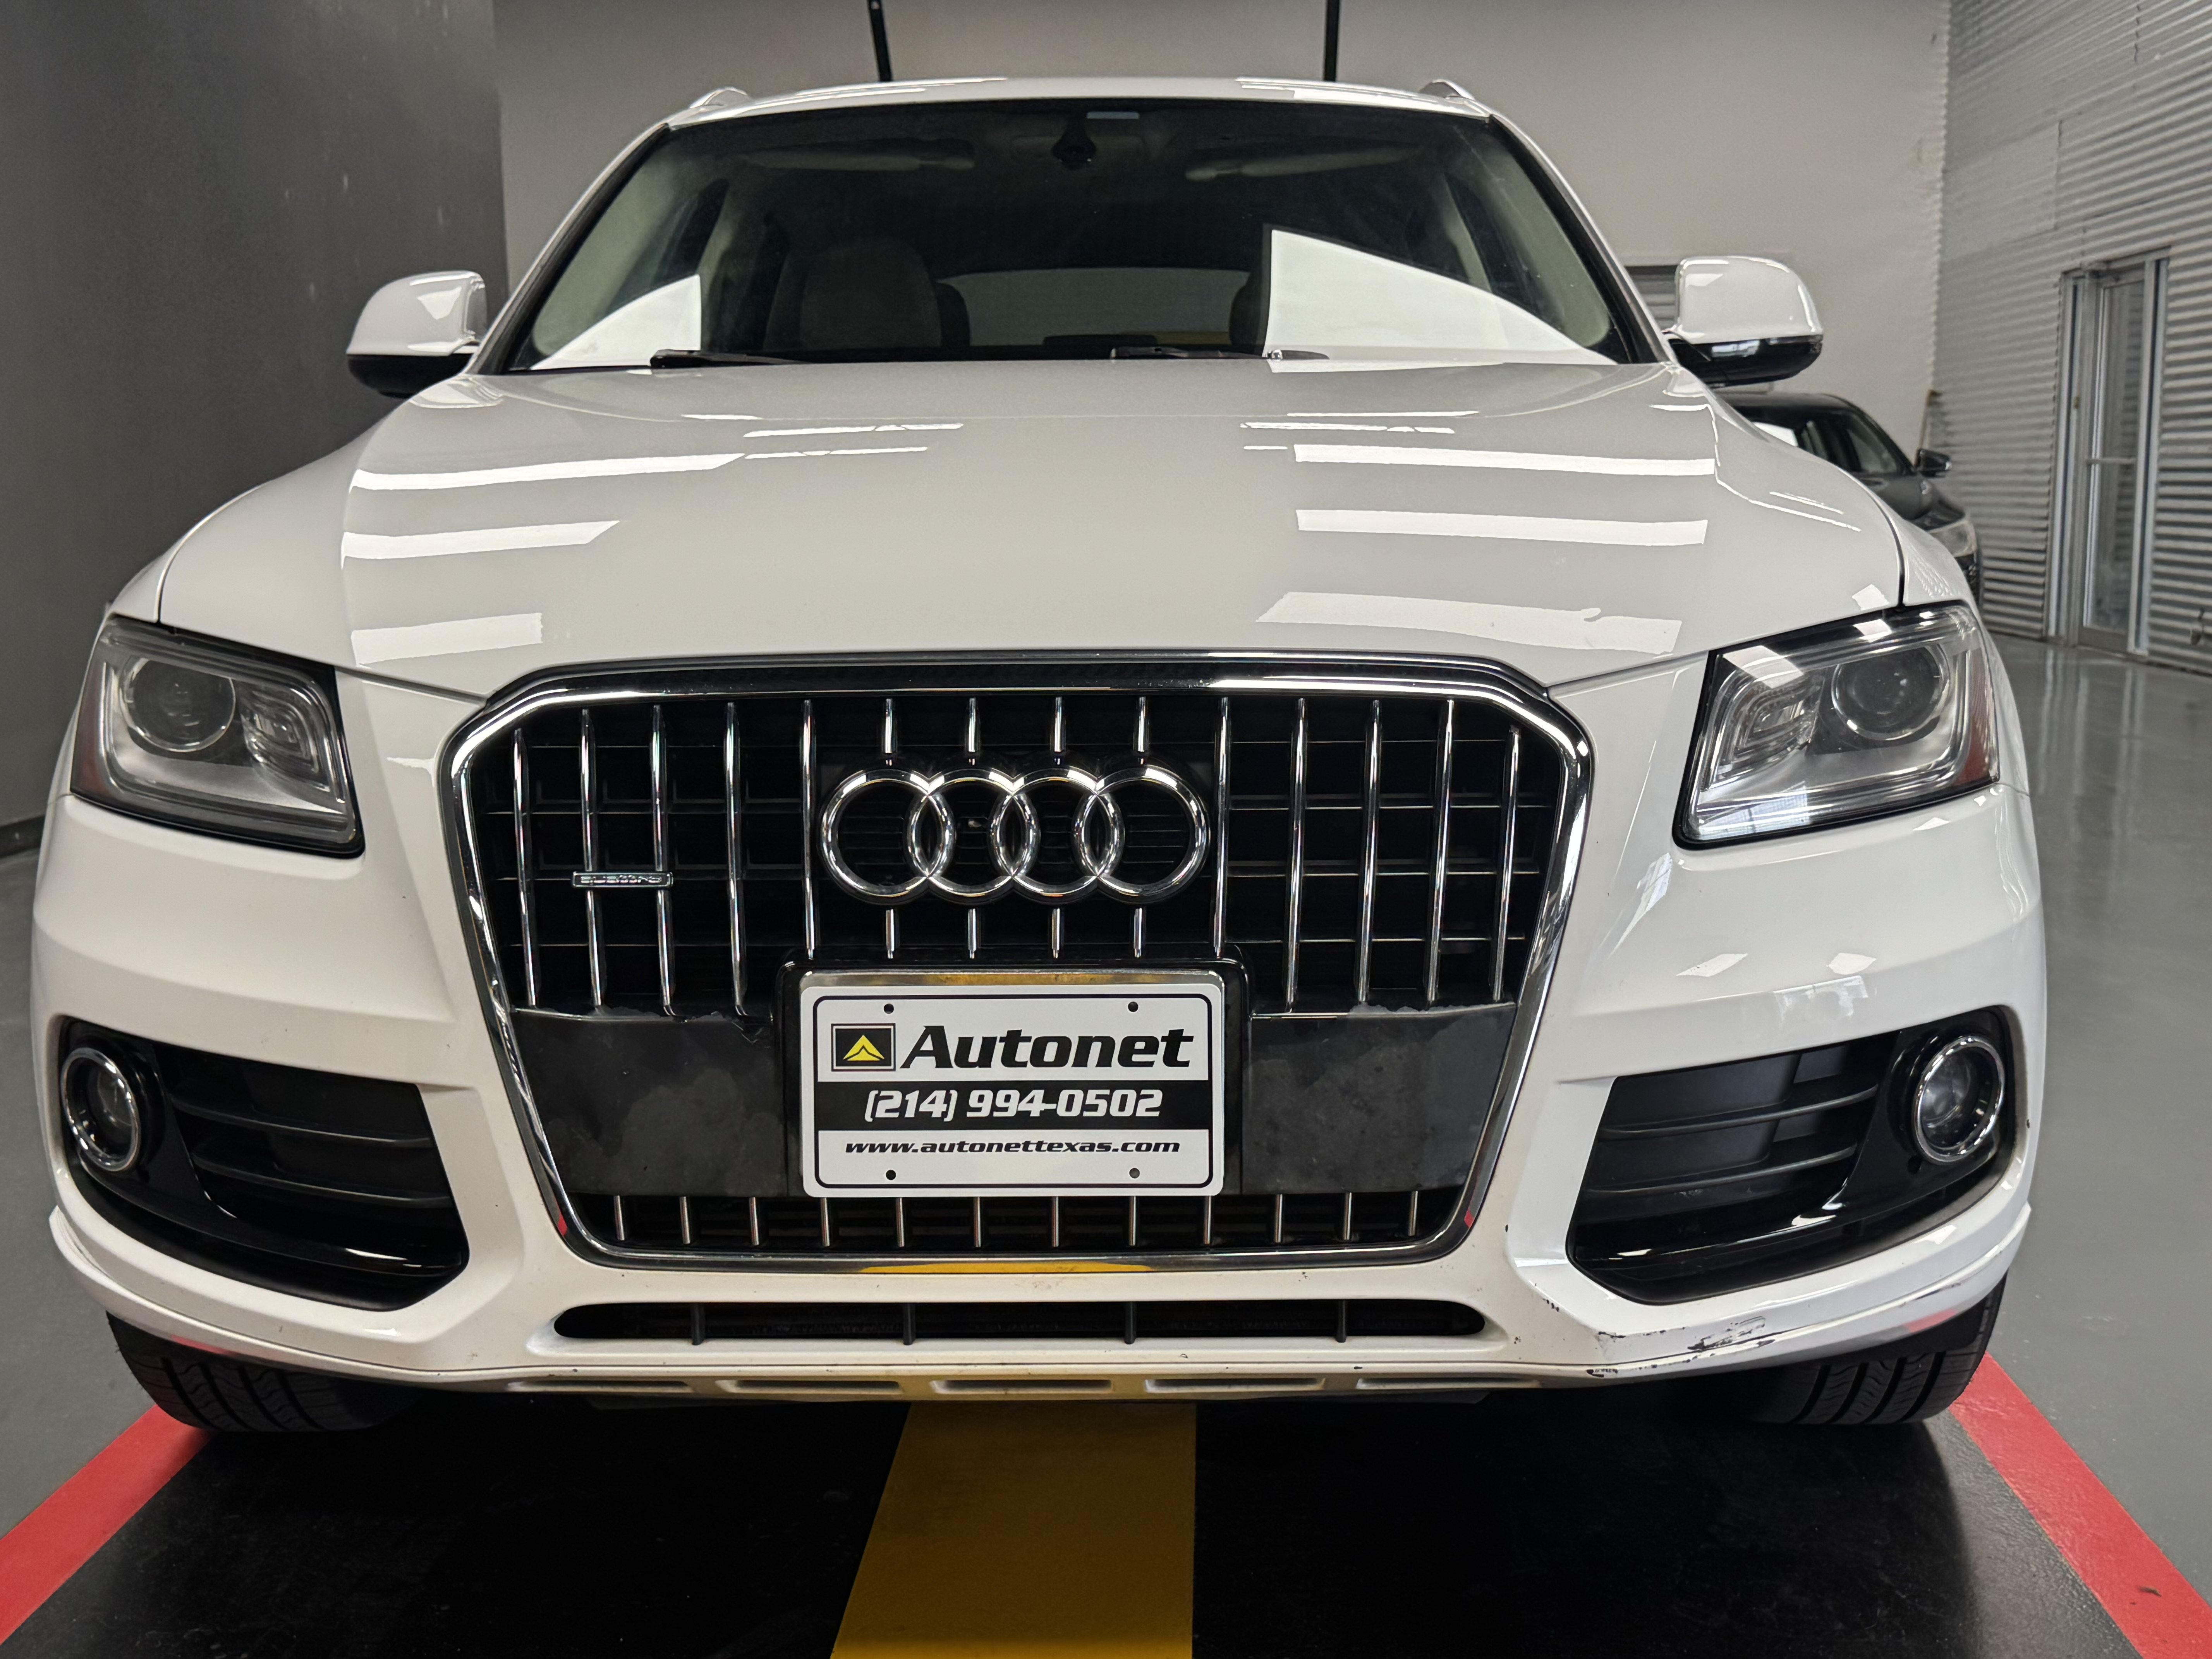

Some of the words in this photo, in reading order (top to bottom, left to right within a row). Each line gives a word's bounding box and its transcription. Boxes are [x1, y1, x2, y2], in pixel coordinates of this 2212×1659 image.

[900, 1025, 1194, 1069] Autonet
[864, 1089, 958, 1122] (214)
[966, 1089, 1163, 1118] 994-0502
[845, 1140, 1180, 1153] www.autonettexas.com
